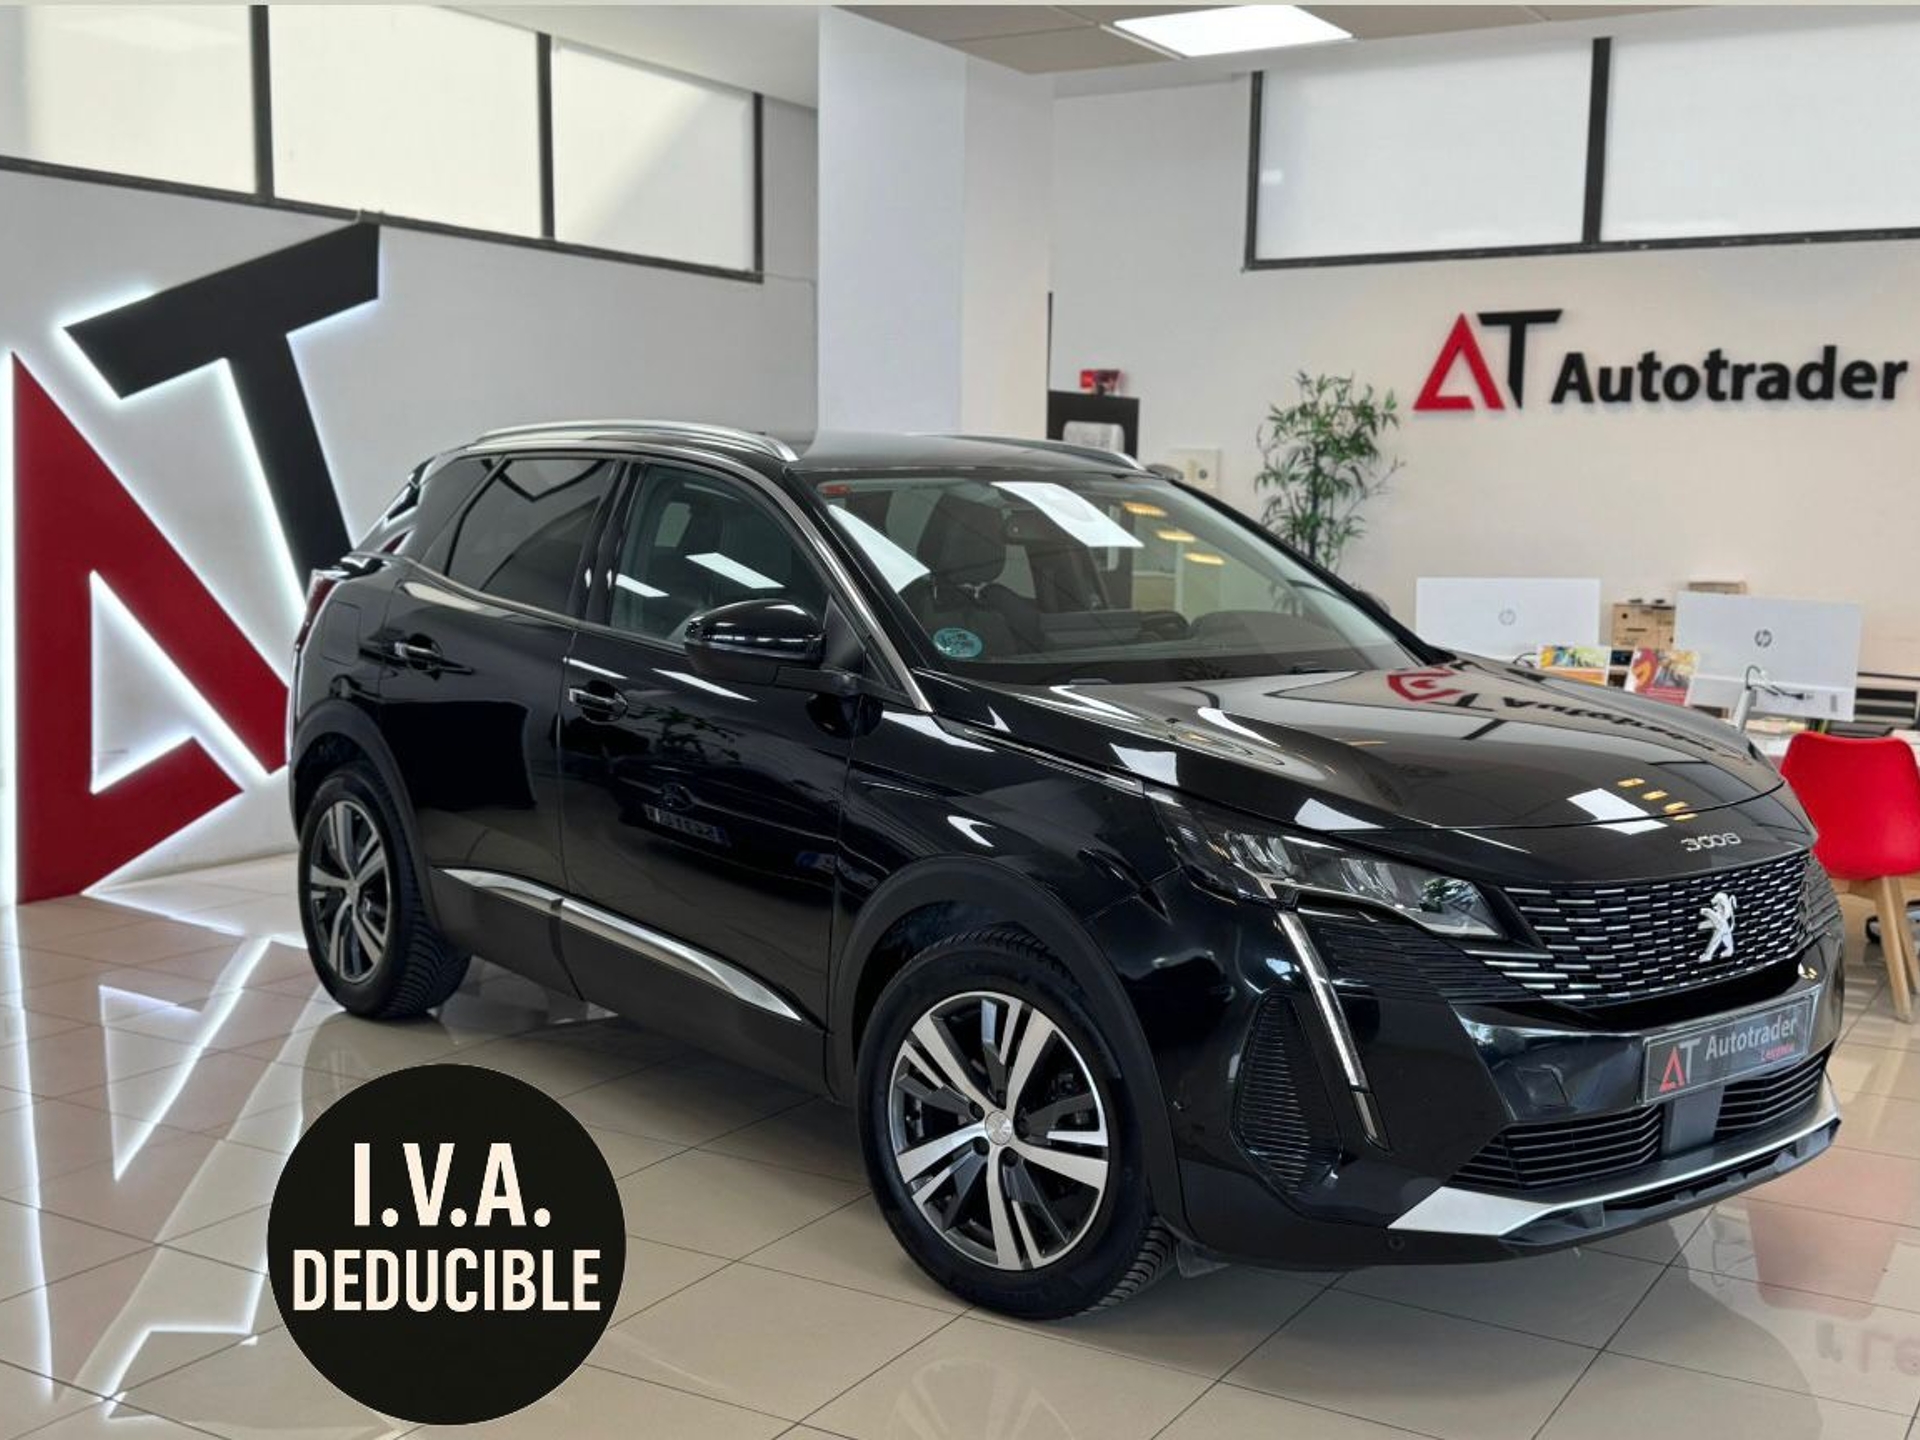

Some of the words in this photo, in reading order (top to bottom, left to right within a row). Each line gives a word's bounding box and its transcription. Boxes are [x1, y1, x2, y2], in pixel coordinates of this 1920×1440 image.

[1412, 308, 1563, 411] AT
[1550, 345, 1908, 404] Autotrader
[1681, 833, 1742, 852] 3008
[1705, 1014, 1799, 1061] Autotrader
